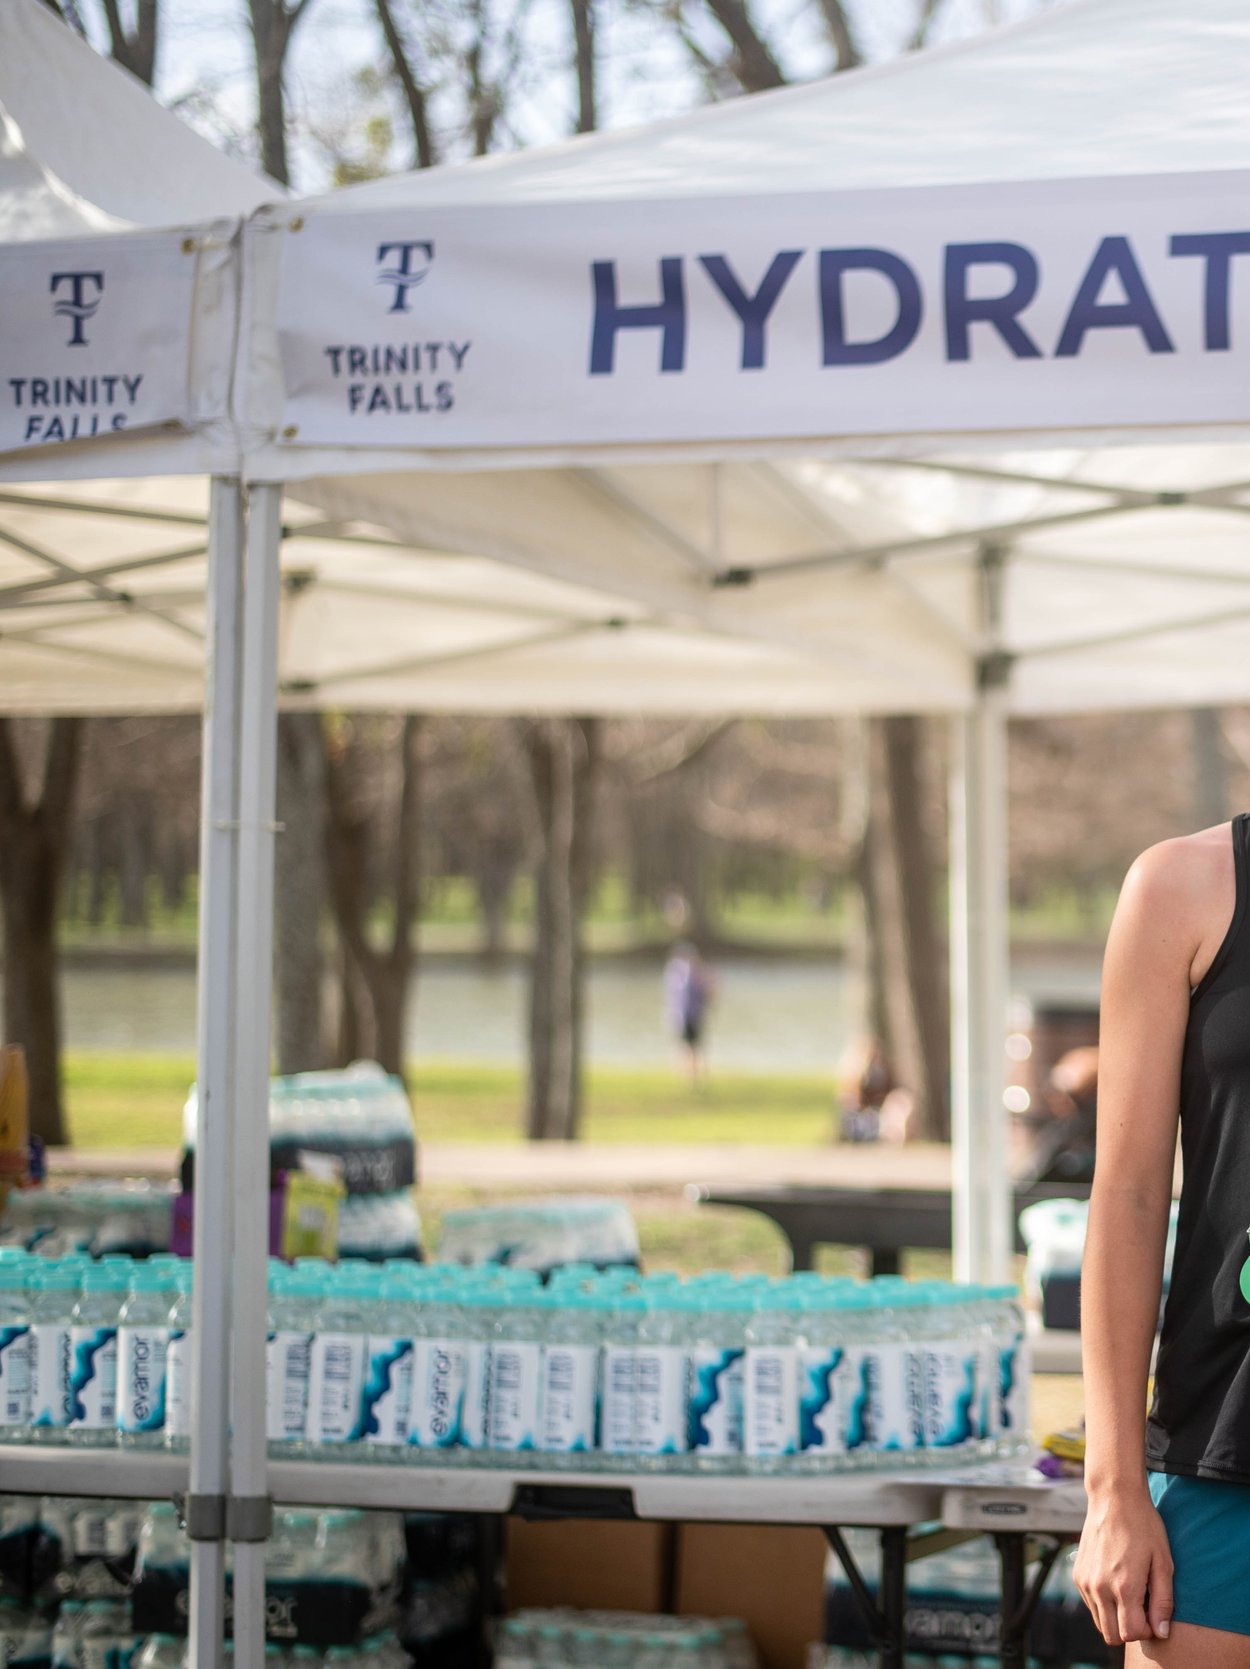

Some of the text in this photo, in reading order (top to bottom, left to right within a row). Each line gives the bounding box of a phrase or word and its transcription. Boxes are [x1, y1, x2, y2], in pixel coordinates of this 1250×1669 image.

[325, 342, 471, 378] TRINITY
[8, 374, 143, 407] TRINITY
[348, 381, 456, 416] FALLS
[134, 1334, 149, 1420] evamor
[430, 1345, 452, 1436] evamor
